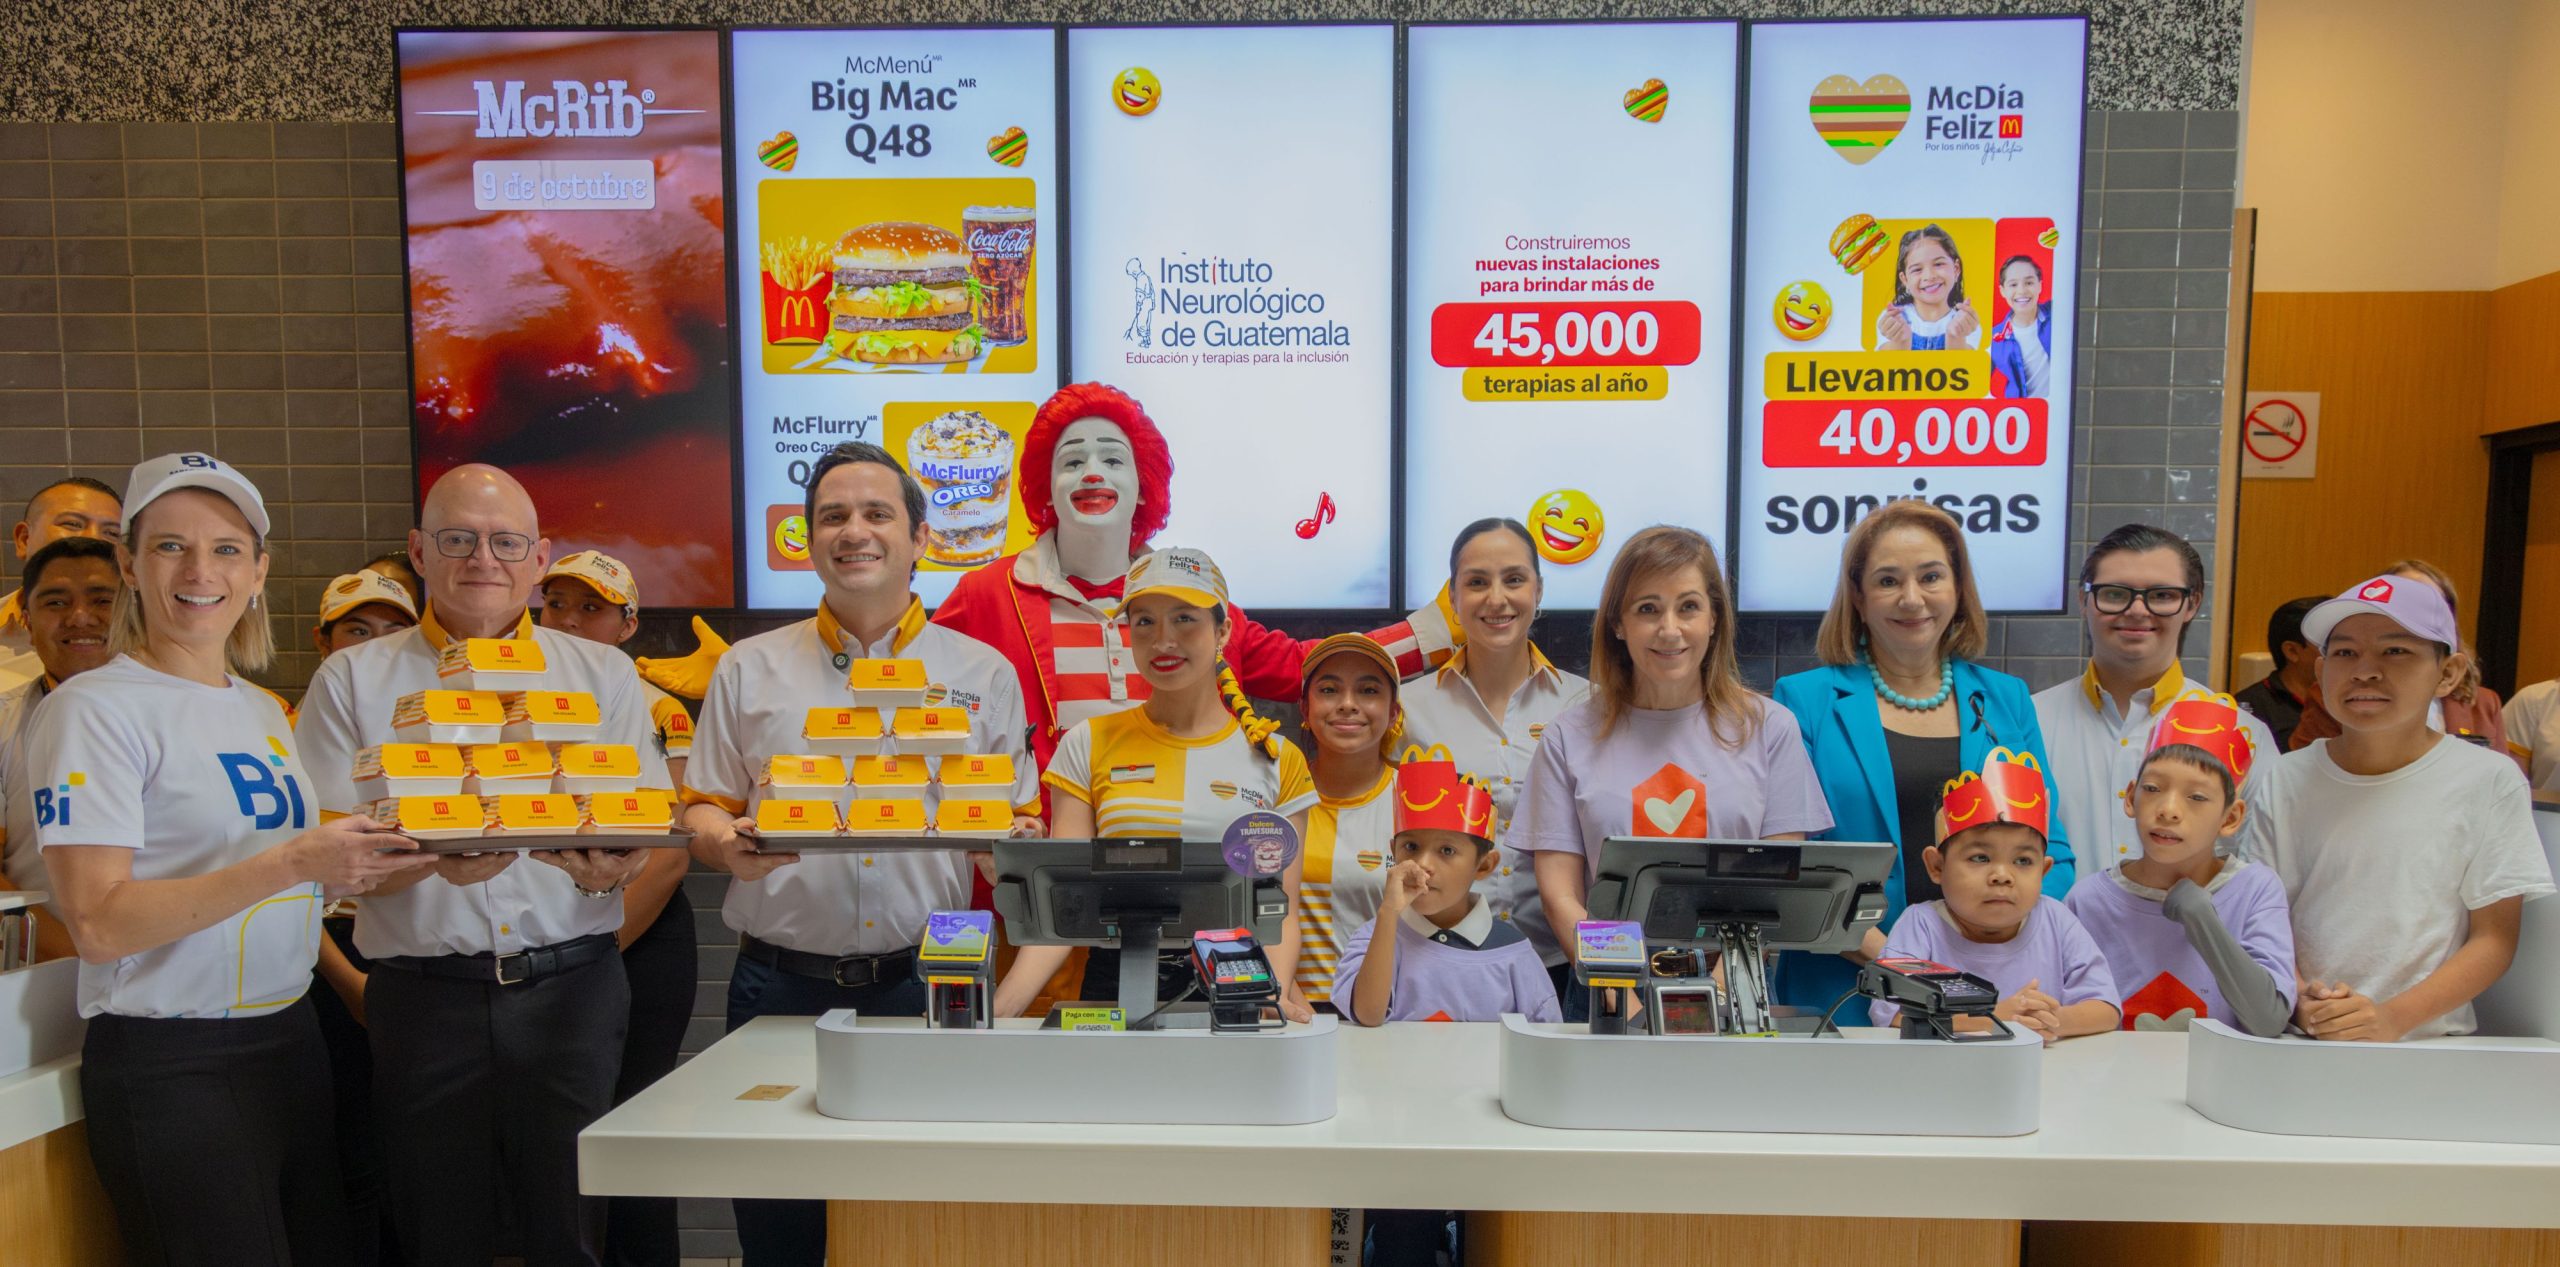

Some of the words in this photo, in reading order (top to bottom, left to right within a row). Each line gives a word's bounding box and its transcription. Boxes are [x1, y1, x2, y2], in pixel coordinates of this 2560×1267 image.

[845, 54, 932, 74] McMenú
[811, 78, 870, 121] Big
[879, 80, 957, 111] Mac
[1927, 83, 2024, 110] McDía
[1926, 113, 1996, 140] Feliz
[845, 123, 932, 164] Q48
[1925, 143, 1940, 151] Por
[1941, 143, 1954, 151] los
[1956, 143, 1980, 151] niños
[481, 171, 498, 201] 9
[503, 172, 535, 200] de
[541, 170, 648, 200] octubre
[1505, 234, 1631, 250] Construiremos
[1161, 256, 1273, 285] Instituto
[1475, 257, 1538, 271] nuevas
[1542, 254, 1660, 271] instalaciones
[1480, 279, 1519, 296] para
[1523, 276, 1588, 292] brindar
[1591, 275, 1629, 291] más
[1632, 276, 1655, 291] de
[1161, 287, 1325, 321] Neurológico
[1161, 320, 1196, 347] de
[1203, 320, 1350, 347] Guatemala
[1473, 311, 1659, 365] 45,000
[1126, 352, 1189, 364] Educación
[1192, 354, 1199, 366] y
[1202, 352, 1250, 366] terapias
[1253, 354, 1280, 366] para
[1283, 352, 1293, 363] la
[1296, 351, 1349, 363] inclusión
[1483, 372, 1576, 398] terapias
[1581, 373, 1601, 393] al
[1606, 372, 1649, 393] año
[1786, 360, 1969, 393] Llevamos
[772, 415, 868, 439] McFlurry
[1819, 406, 2031, 464] 40,000
[775, 441, 808, 453] Oreo
[180, 455, 218, 471] Bi
[921, 462, 1000, 482] McFlurry
[934, 483, 991, 505] OREO
[942, 508, 981, 516] Caramelo
[216, 752, 306, 831] Bi
[34, 784, 71, 830] Bi
[1240, 827, 1284, 836] TRAVESURAS
[1065, 1011, 1082, 1019] Paga
